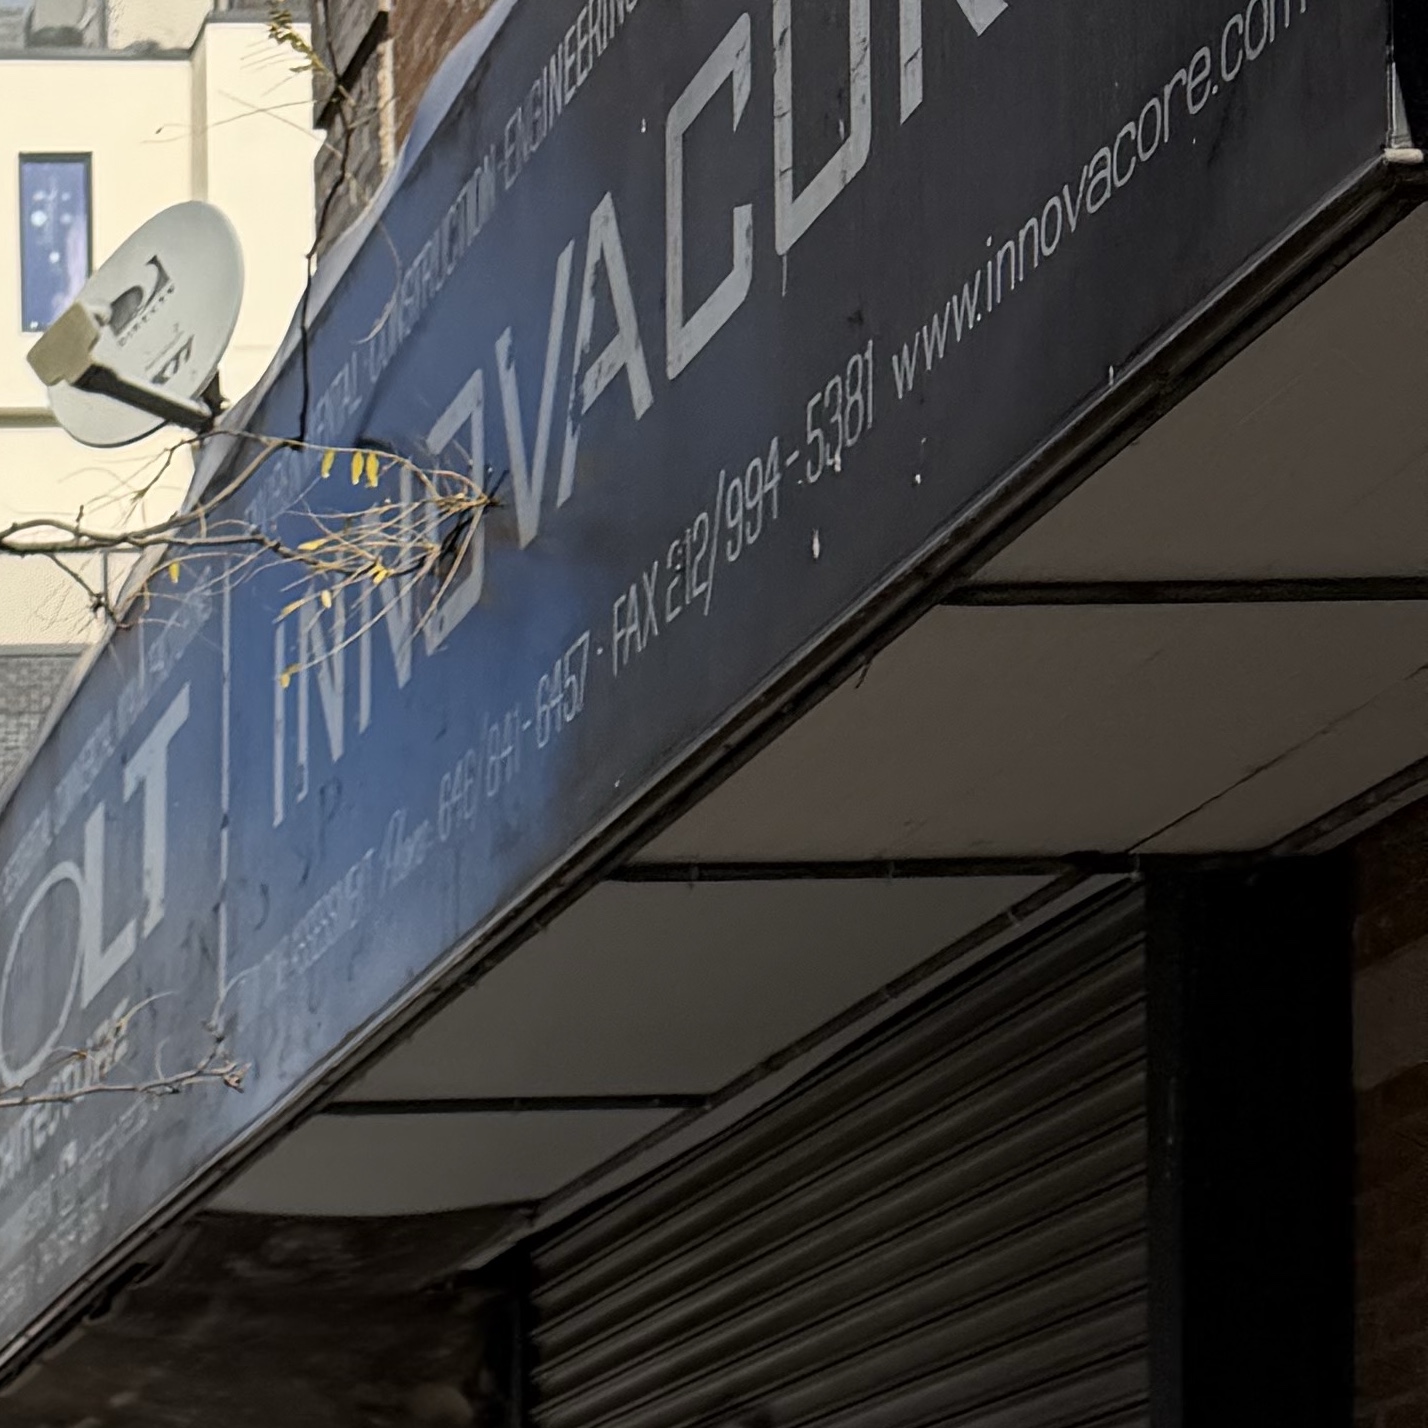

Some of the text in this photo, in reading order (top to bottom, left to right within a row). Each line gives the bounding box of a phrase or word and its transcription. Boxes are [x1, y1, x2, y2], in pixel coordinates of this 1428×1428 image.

[504, 0, 639, 190] ENGINEERI
[273, 0, 1008, 829] INNOVACO
[611, 560, 658, 676] FAX
[665, 339, 874, 623] 212/994-5381
